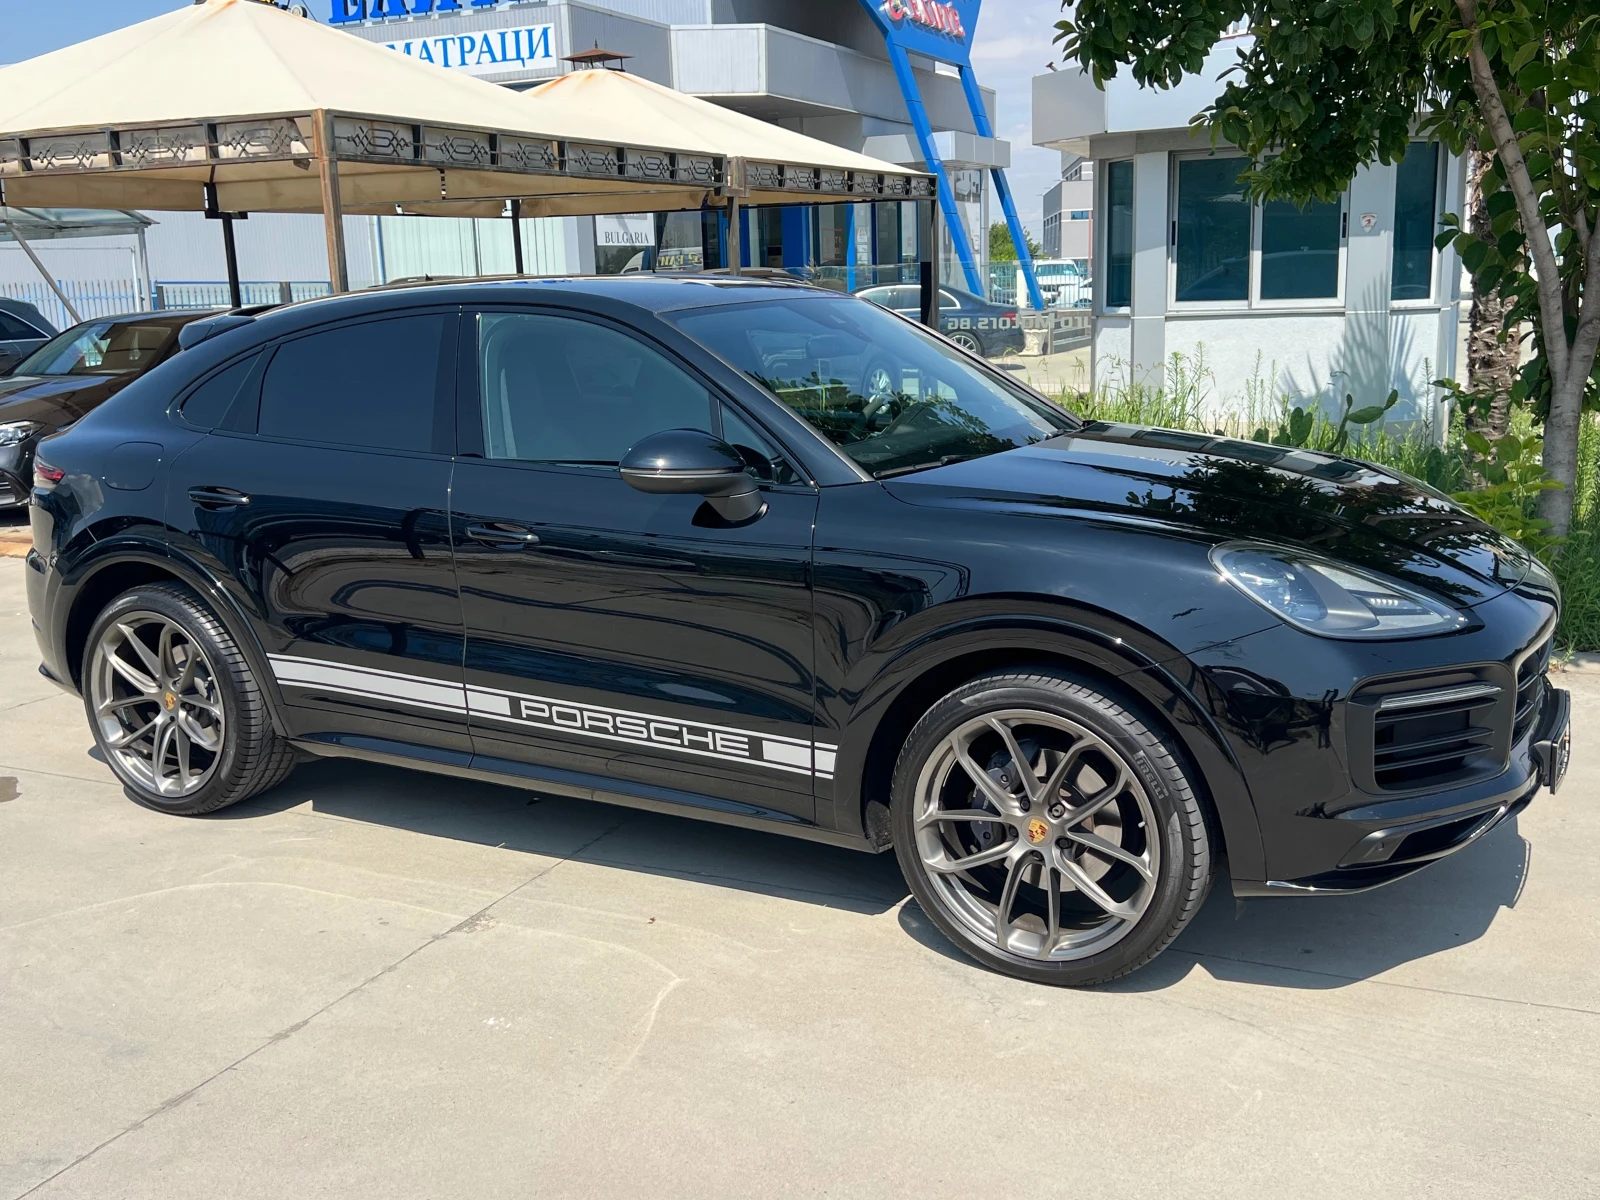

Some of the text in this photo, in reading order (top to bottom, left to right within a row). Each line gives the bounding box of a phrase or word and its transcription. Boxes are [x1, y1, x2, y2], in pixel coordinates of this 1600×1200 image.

[604, 231, 650, 244] BULGARIA
[519, 699, 750, 757] PORSCHE
[1133, 750, 1169, 800] PIRELLI
